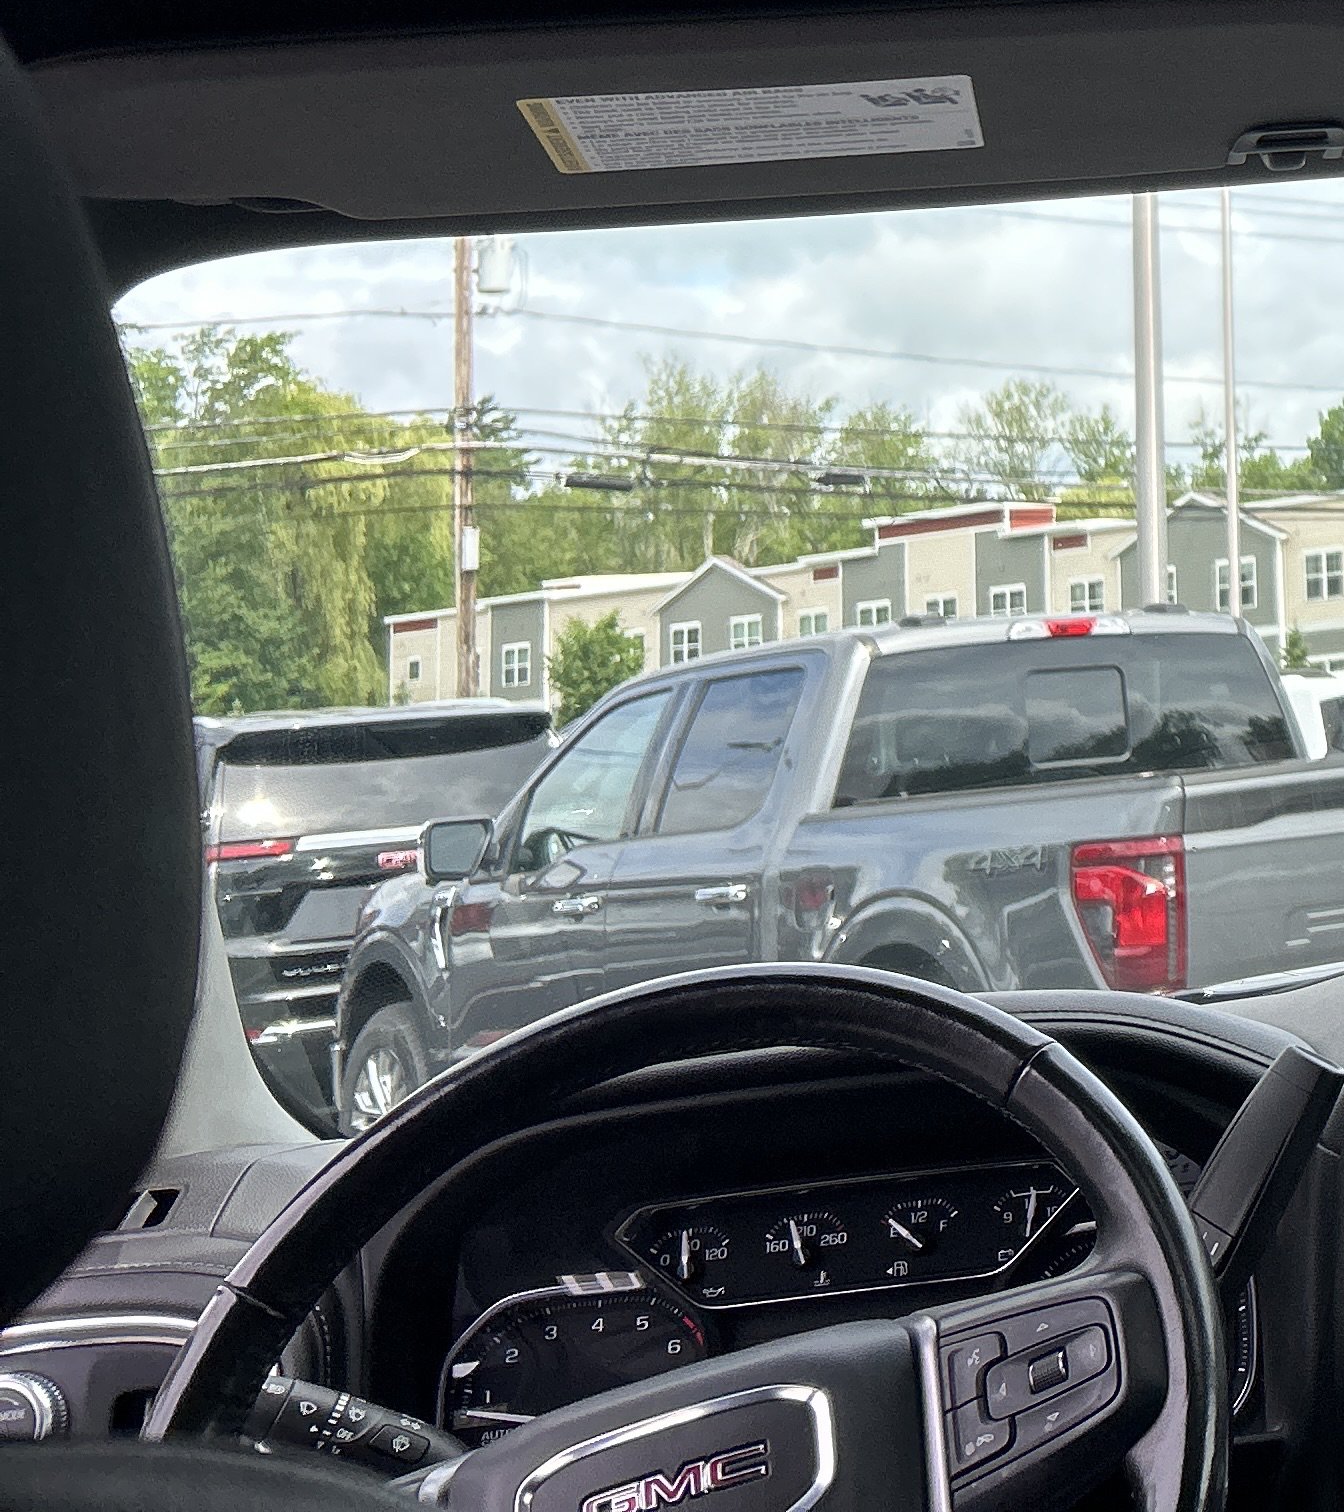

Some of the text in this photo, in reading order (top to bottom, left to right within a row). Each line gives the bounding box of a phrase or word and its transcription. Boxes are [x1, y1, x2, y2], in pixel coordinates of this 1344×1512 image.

[911, 1210, 928, 1224] 1/2
[1003, 1211, 1013, 1224] 9
[939, 1219, 948, 1233] F
[766, 1239, 789, 1254] 160
[820, 1232, 848, 1247] 260
[660, 1254, 670, 1266] 0
[705, 1246, 728, 1262] 120
[592, 1317, 605, 1332] 4
[636, 1315, 649, 1331] 5
[544, 1325, 558, 1340] 3
[667, 1339, 681, 1354] 6
[505, 1348, 519, 1363] 2
[484, 1390, 491, 1404] 1
[481, 1429, 511, 1441] AUT
[580, 1441, 769, 1512] GMC
